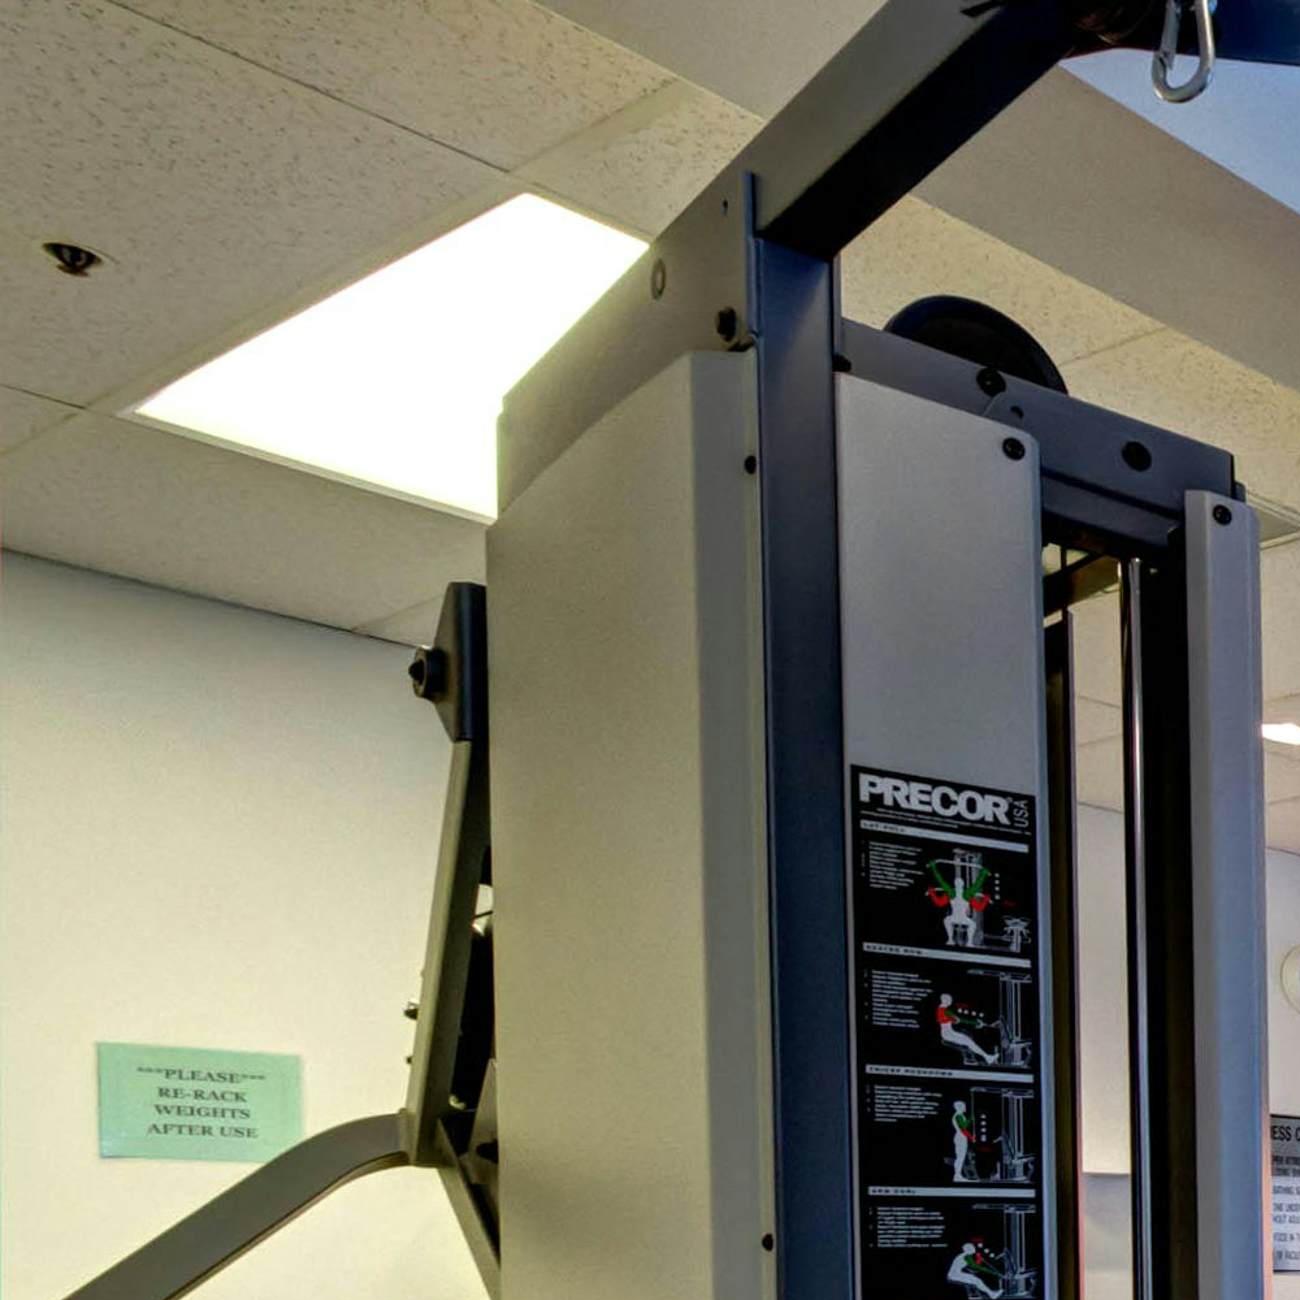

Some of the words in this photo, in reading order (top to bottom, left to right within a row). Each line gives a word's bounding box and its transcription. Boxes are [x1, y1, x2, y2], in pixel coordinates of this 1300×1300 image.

[859, 773, 1011, 825] PRECOR
[1014, 800, 1029, 828] USA
[157, 1086, 248, 1103] RE-RACK
[154, 1104, 251, 1119] WEIGHTS
[147, 1123, 214, 1137] AFTER
[220, 1126, 259, 1139] USE
